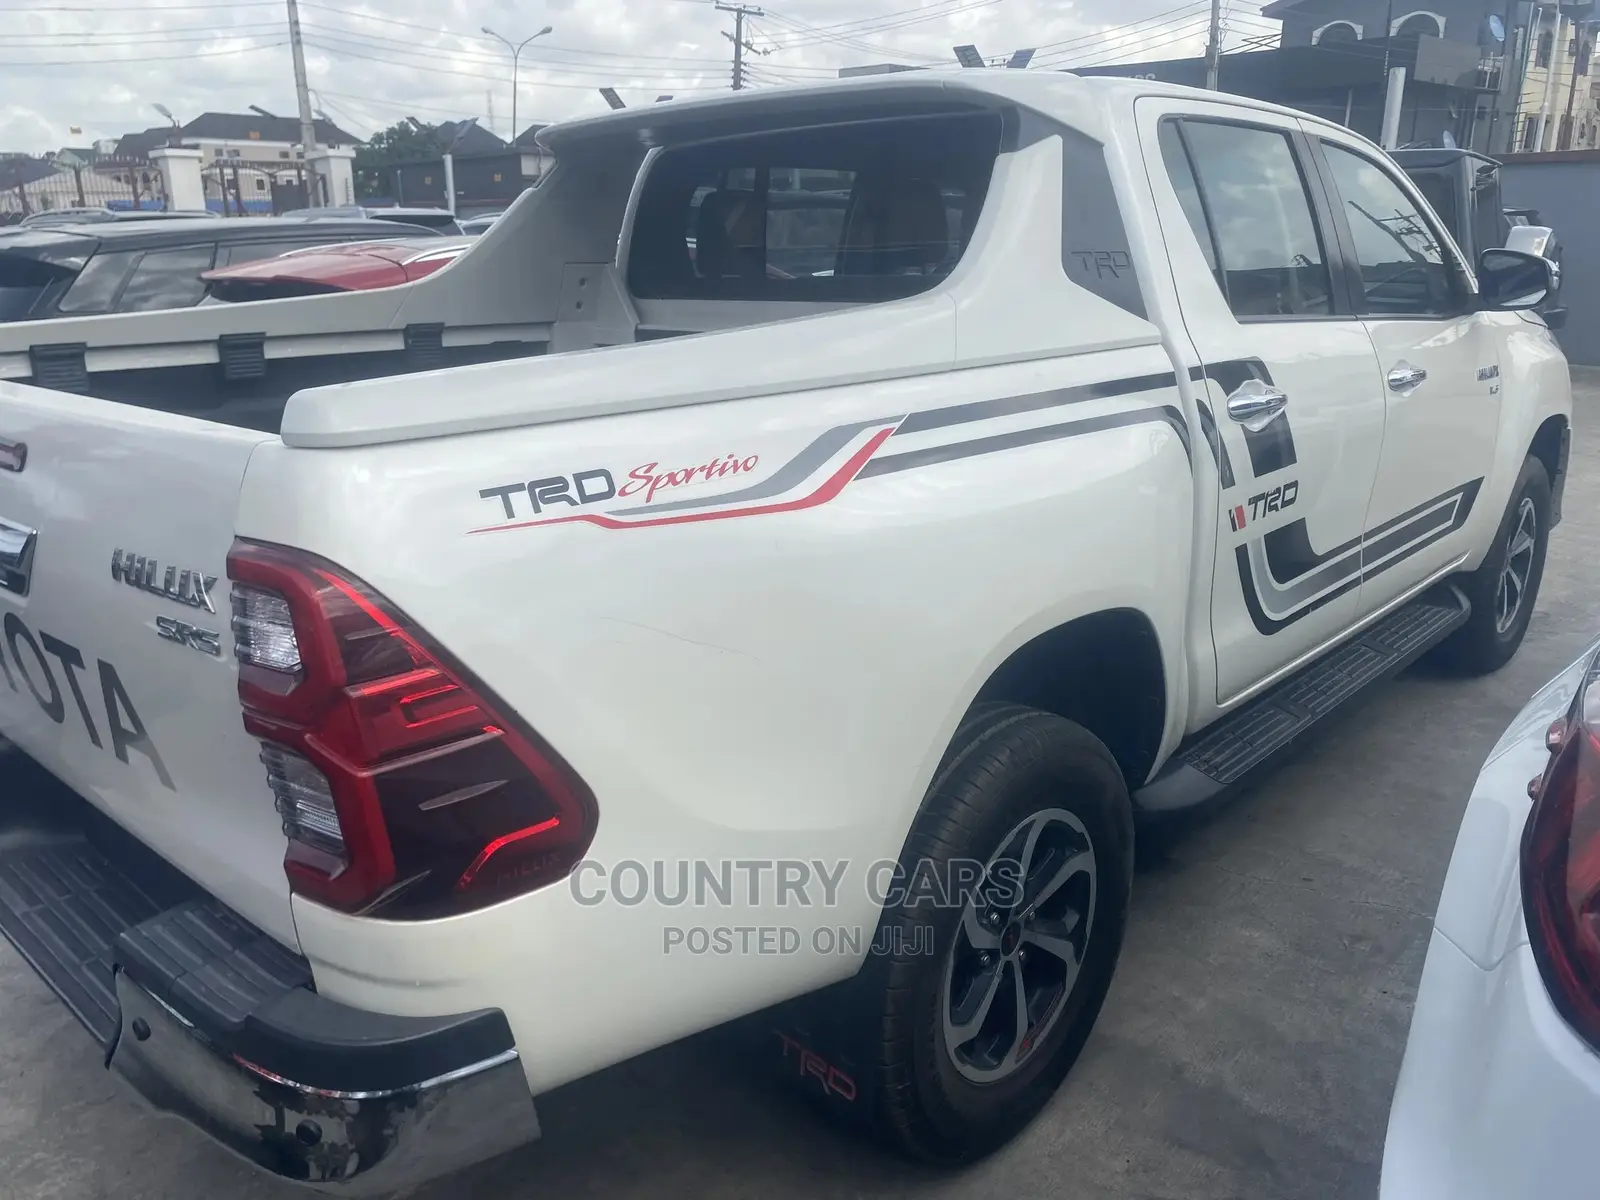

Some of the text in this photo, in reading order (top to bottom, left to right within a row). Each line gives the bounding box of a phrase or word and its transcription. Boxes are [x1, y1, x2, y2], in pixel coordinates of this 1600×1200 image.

[1070, 250, 1131, 280] TRD
[479, 453, 760, 520] TRD Sportivo
[1247, 480, 1299, 521] TRD
[111, 547, 218, 614] HILUX
[0, 612, 178, 793] OTA
[771, 1027, 857, 1102] TRD
